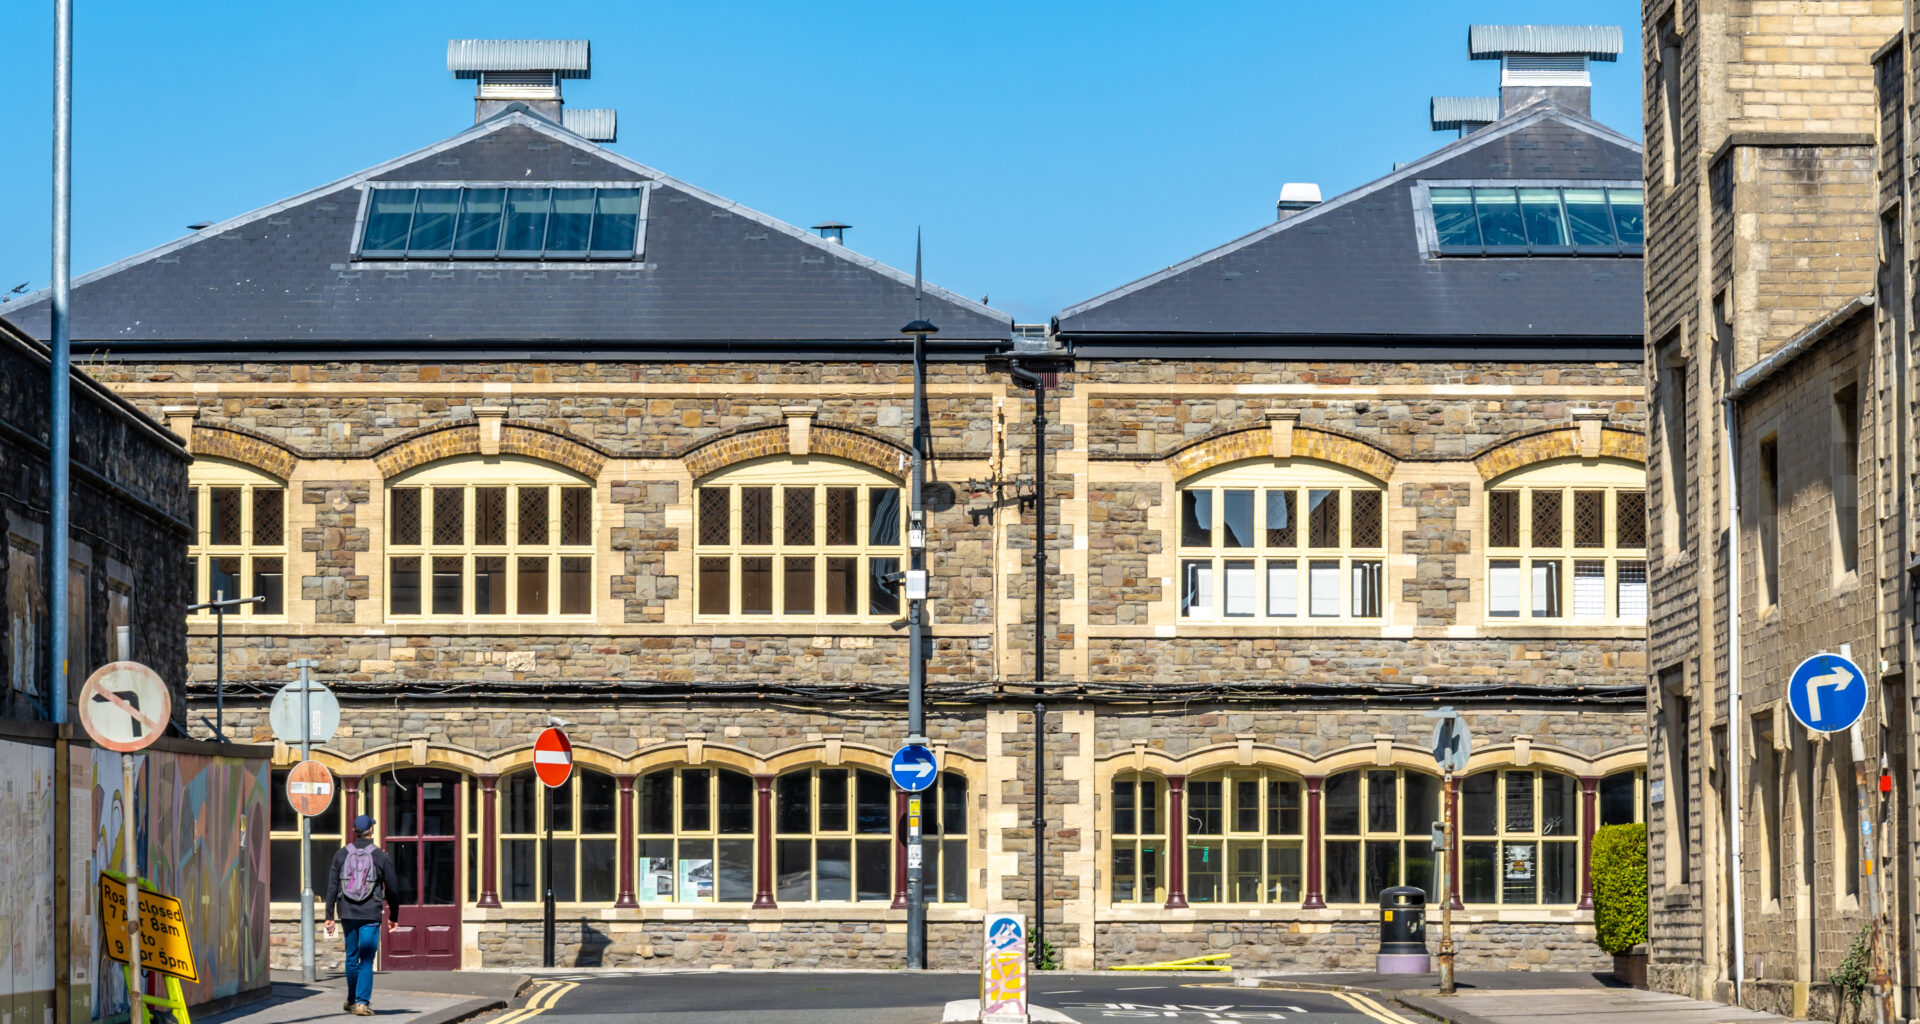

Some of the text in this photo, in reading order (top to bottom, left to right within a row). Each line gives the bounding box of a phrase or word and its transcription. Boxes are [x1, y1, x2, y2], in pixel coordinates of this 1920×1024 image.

[104, 884, 182, 922] Roa closed
[109, 904, 117, 919] 7
[151, 917, 180, 937] 8am
[140, 931, 156, 946] to
[115, 940, 124, 954] 9
[159, 950, 189, 971] 5pm
